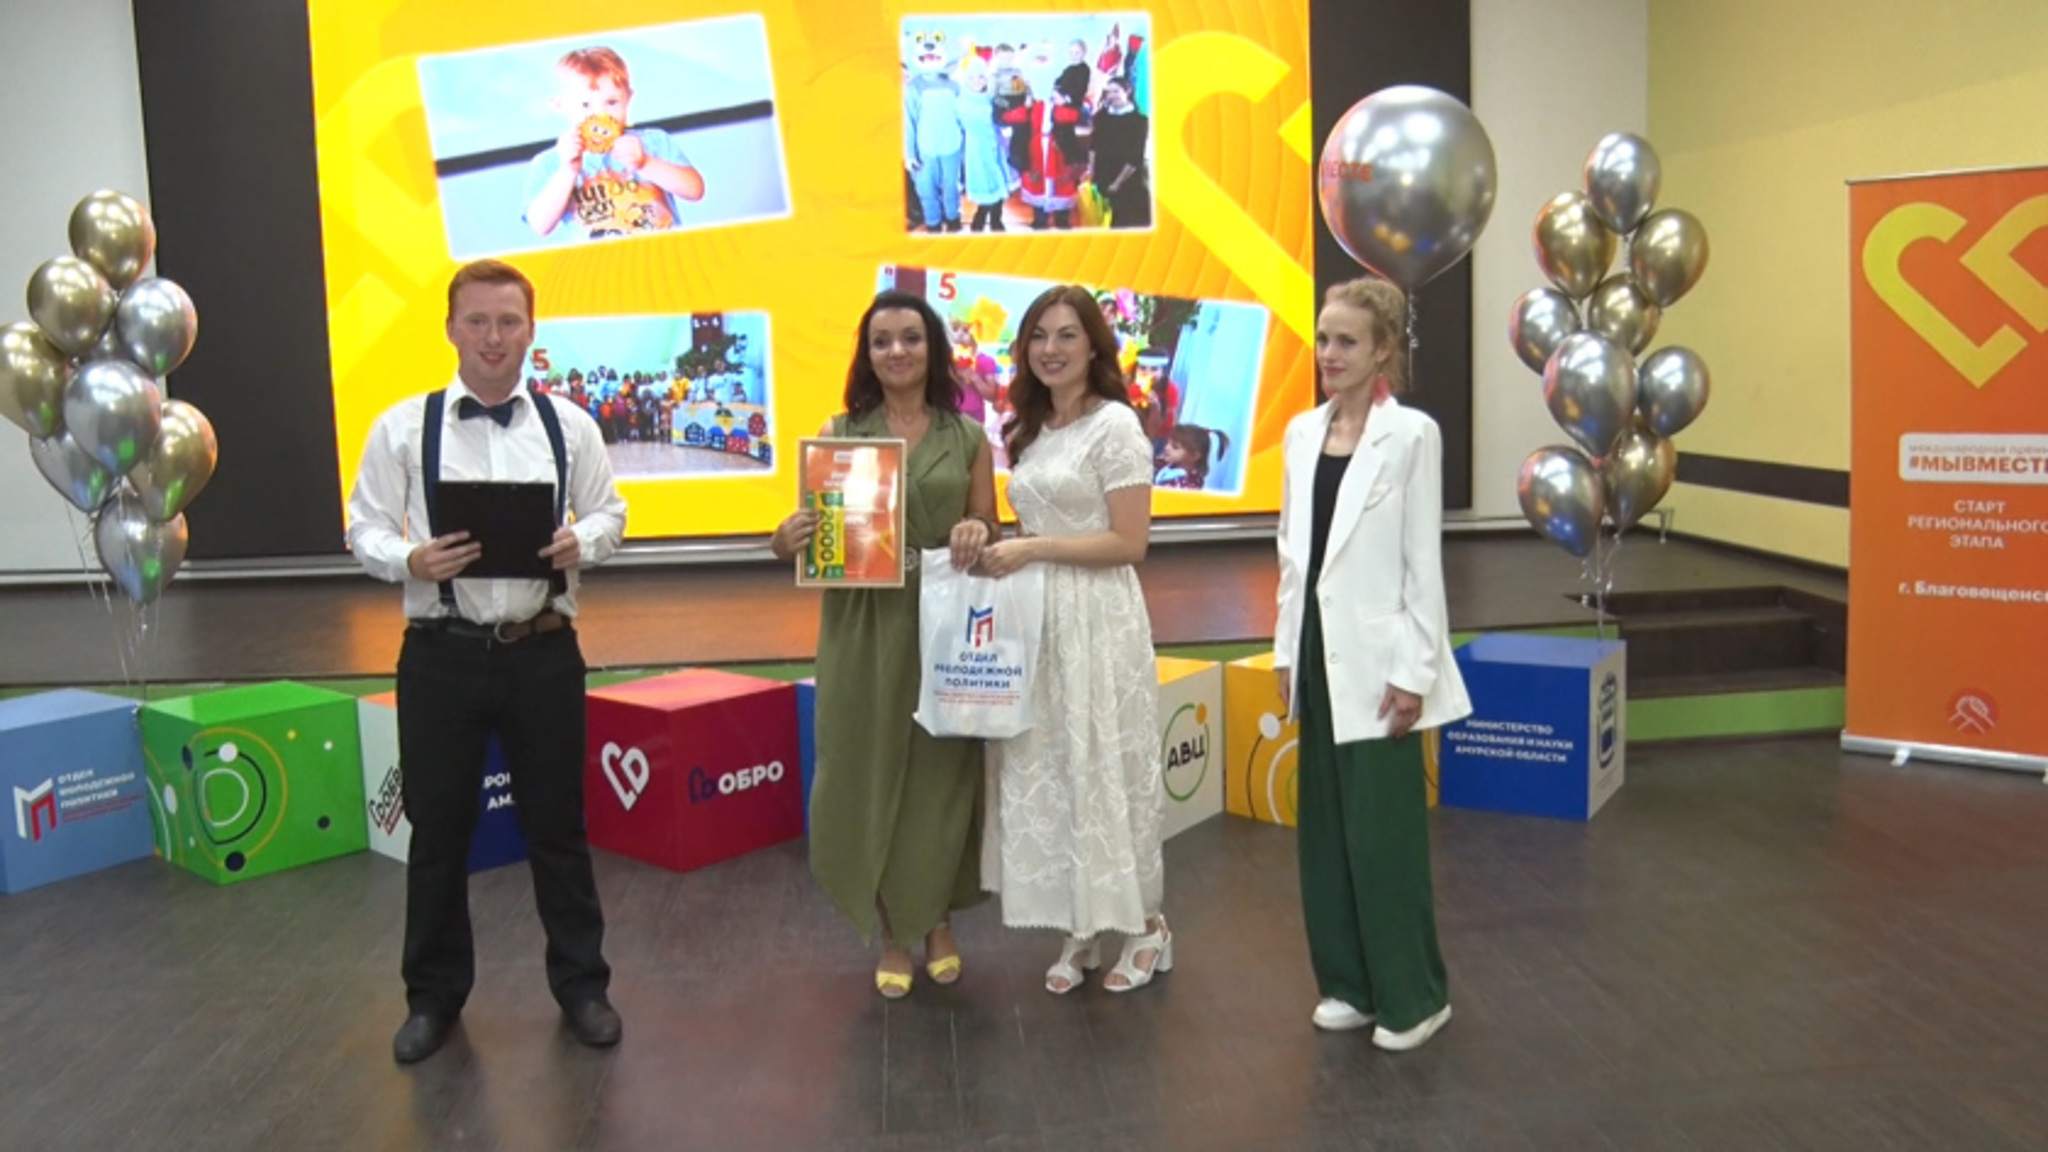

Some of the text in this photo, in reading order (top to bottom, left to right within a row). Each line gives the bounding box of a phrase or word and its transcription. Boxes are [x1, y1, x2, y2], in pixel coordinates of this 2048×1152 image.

[939, 272, 957, 301] 5
[1953, 499, 2006, 514] СТАРТ
[1949, 534, 2005, 549] ЭТАПА
[1167, 733, 1206, 772] АВЦ
